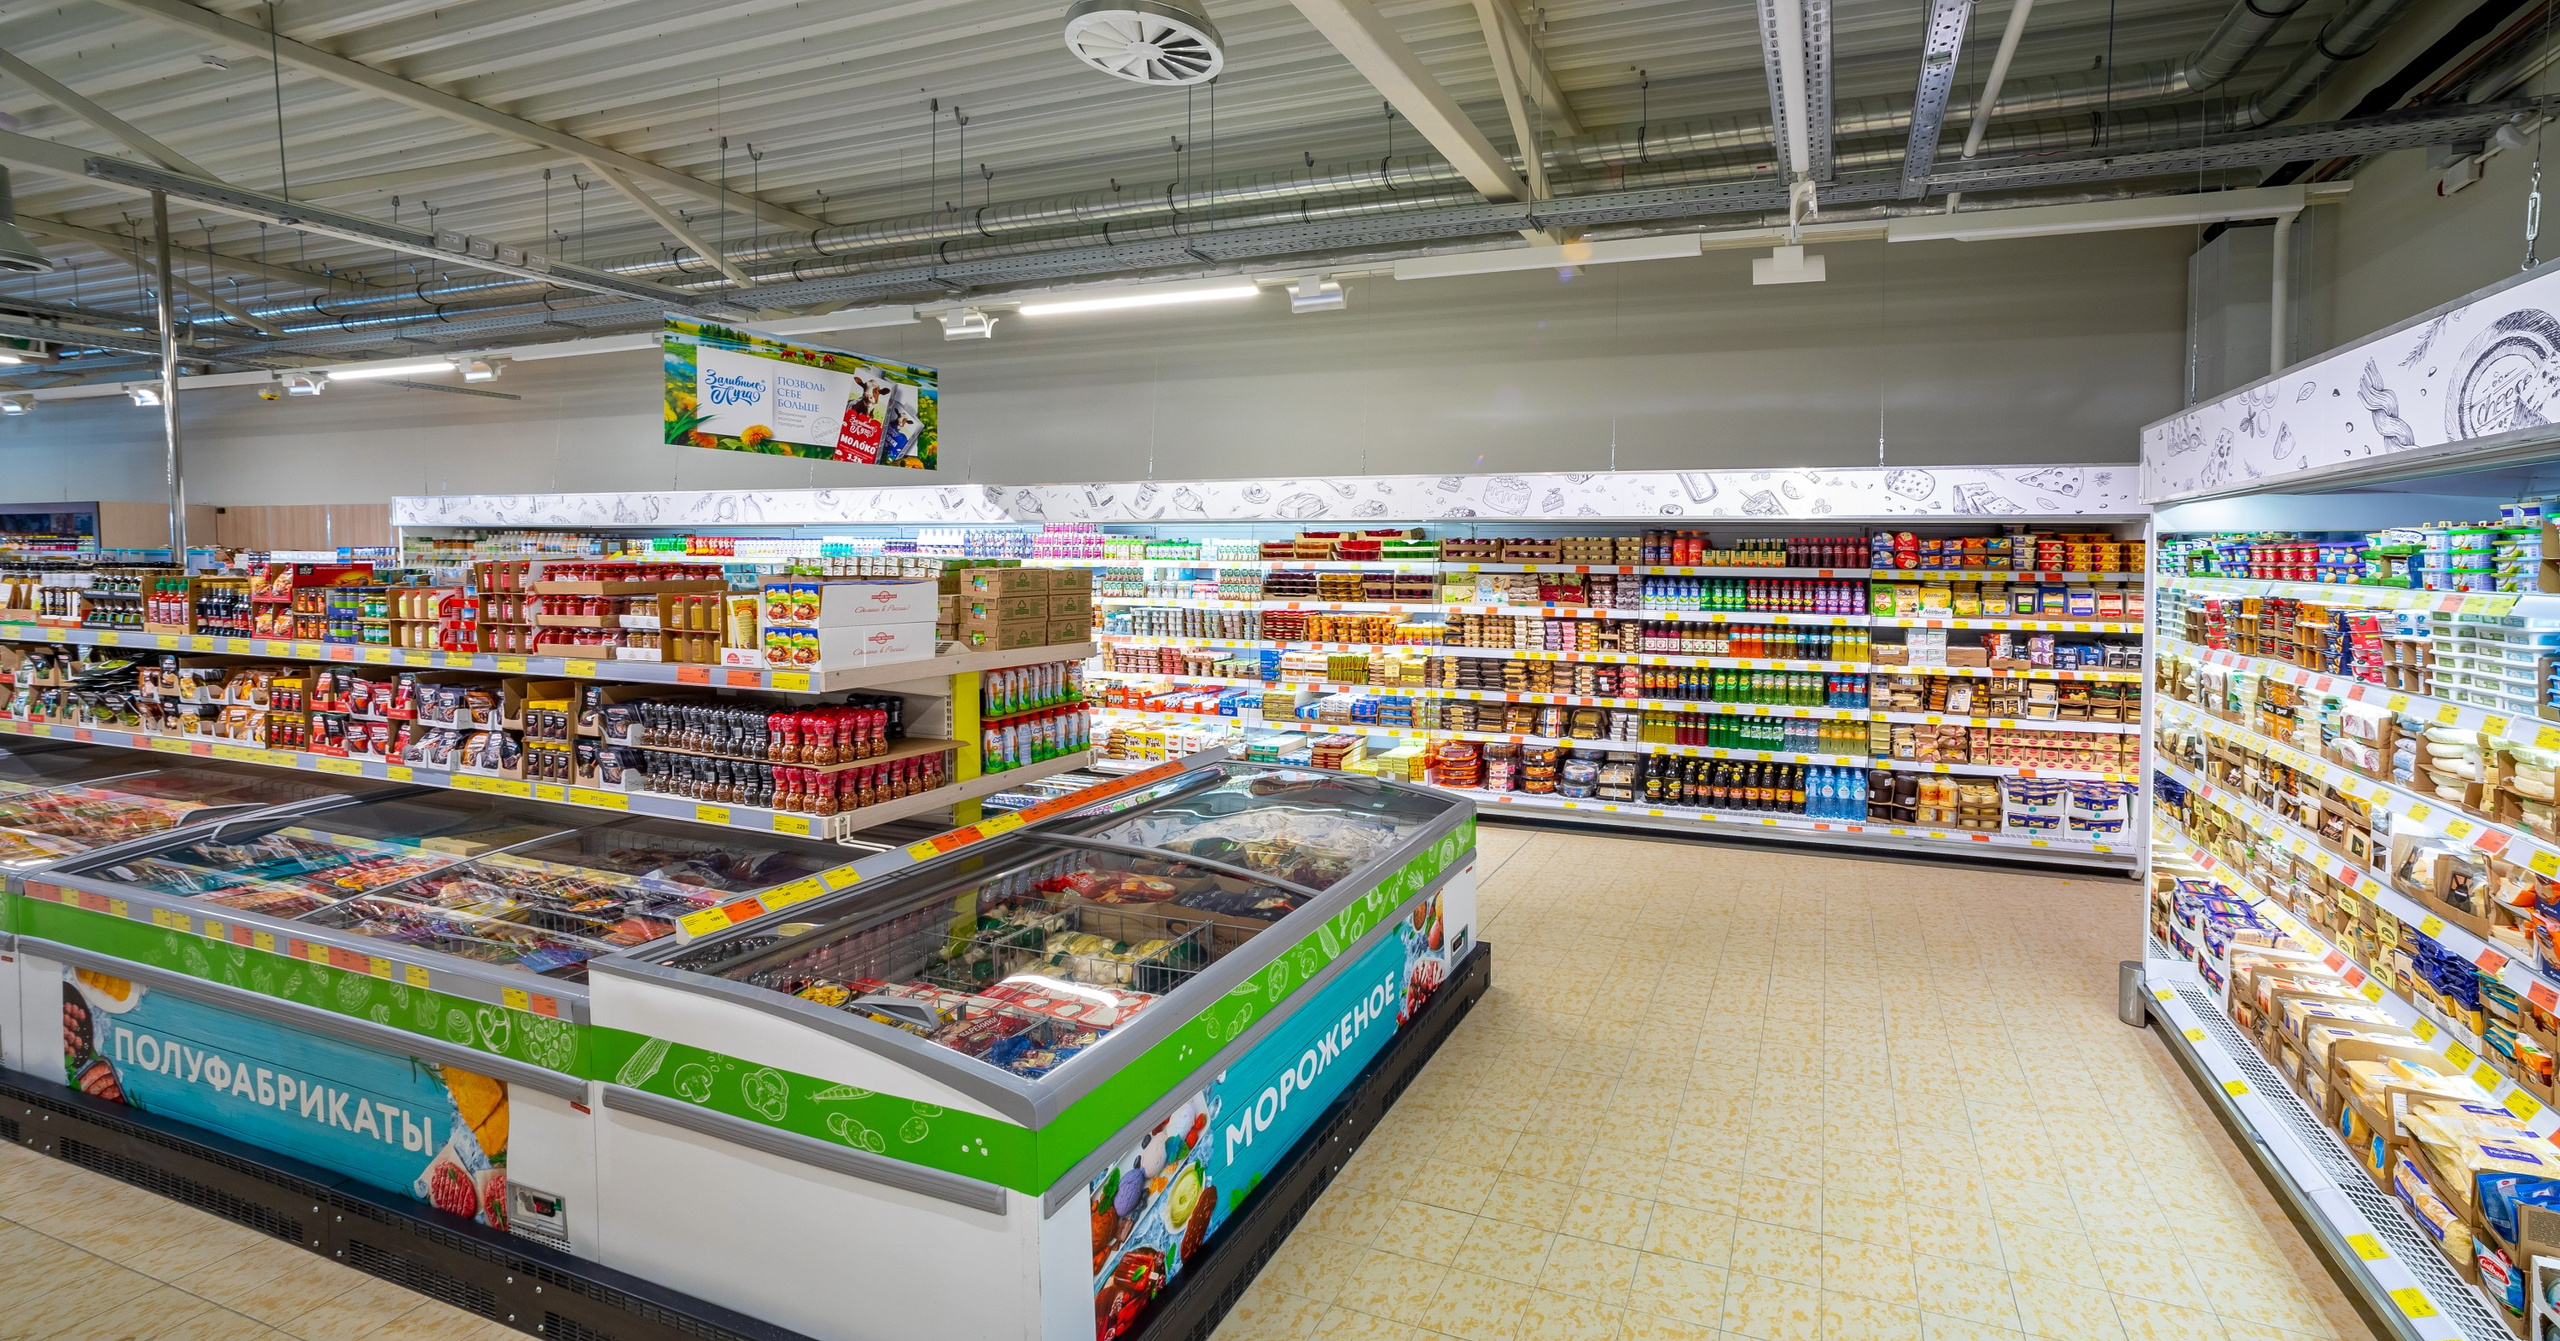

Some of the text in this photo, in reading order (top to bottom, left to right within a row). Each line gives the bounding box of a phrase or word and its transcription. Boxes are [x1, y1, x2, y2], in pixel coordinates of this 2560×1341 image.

[705, 369, 766, 392] Заливные
[777, 376, 826, 392] ПОЗВОЛЬ
[710, 385, 760, 406] Луга
[777, 387, 802, 399] СЕБЕ
[777, 399, 820, 412] БОЛЬШЕ
[840, 433, 876, 455] МОЛОКО
[1224, 971, 1396, 1166] МОРОЖЕНОЕ
[114, 1026, 433, 1157] ПОЛУФАБРИКАТЫ
[2480, 1258, 2506, 1281] Galbani
